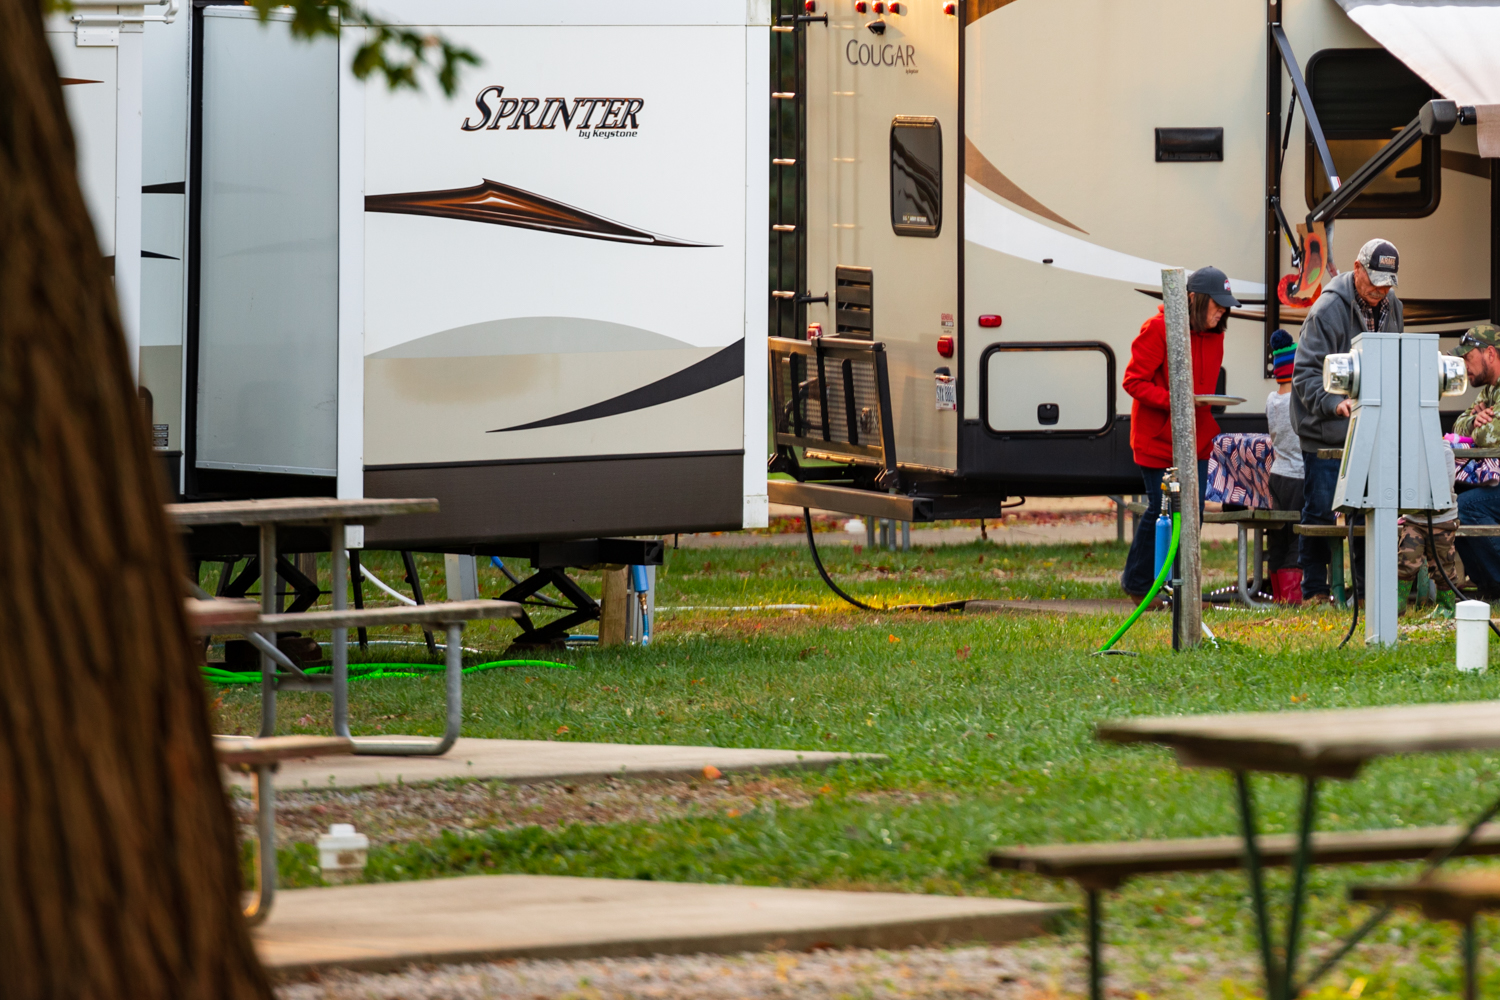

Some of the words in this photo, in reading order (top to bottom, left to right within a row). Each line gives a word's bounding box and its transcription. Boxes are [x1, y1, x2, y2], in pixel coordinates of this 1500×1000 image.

[845, 38, 917, 67] COUGAR
[460, 84, 645, 132] SPRINTER
[578, 129, 591, 139] by
[592, 129, 638, 139] Keystone
